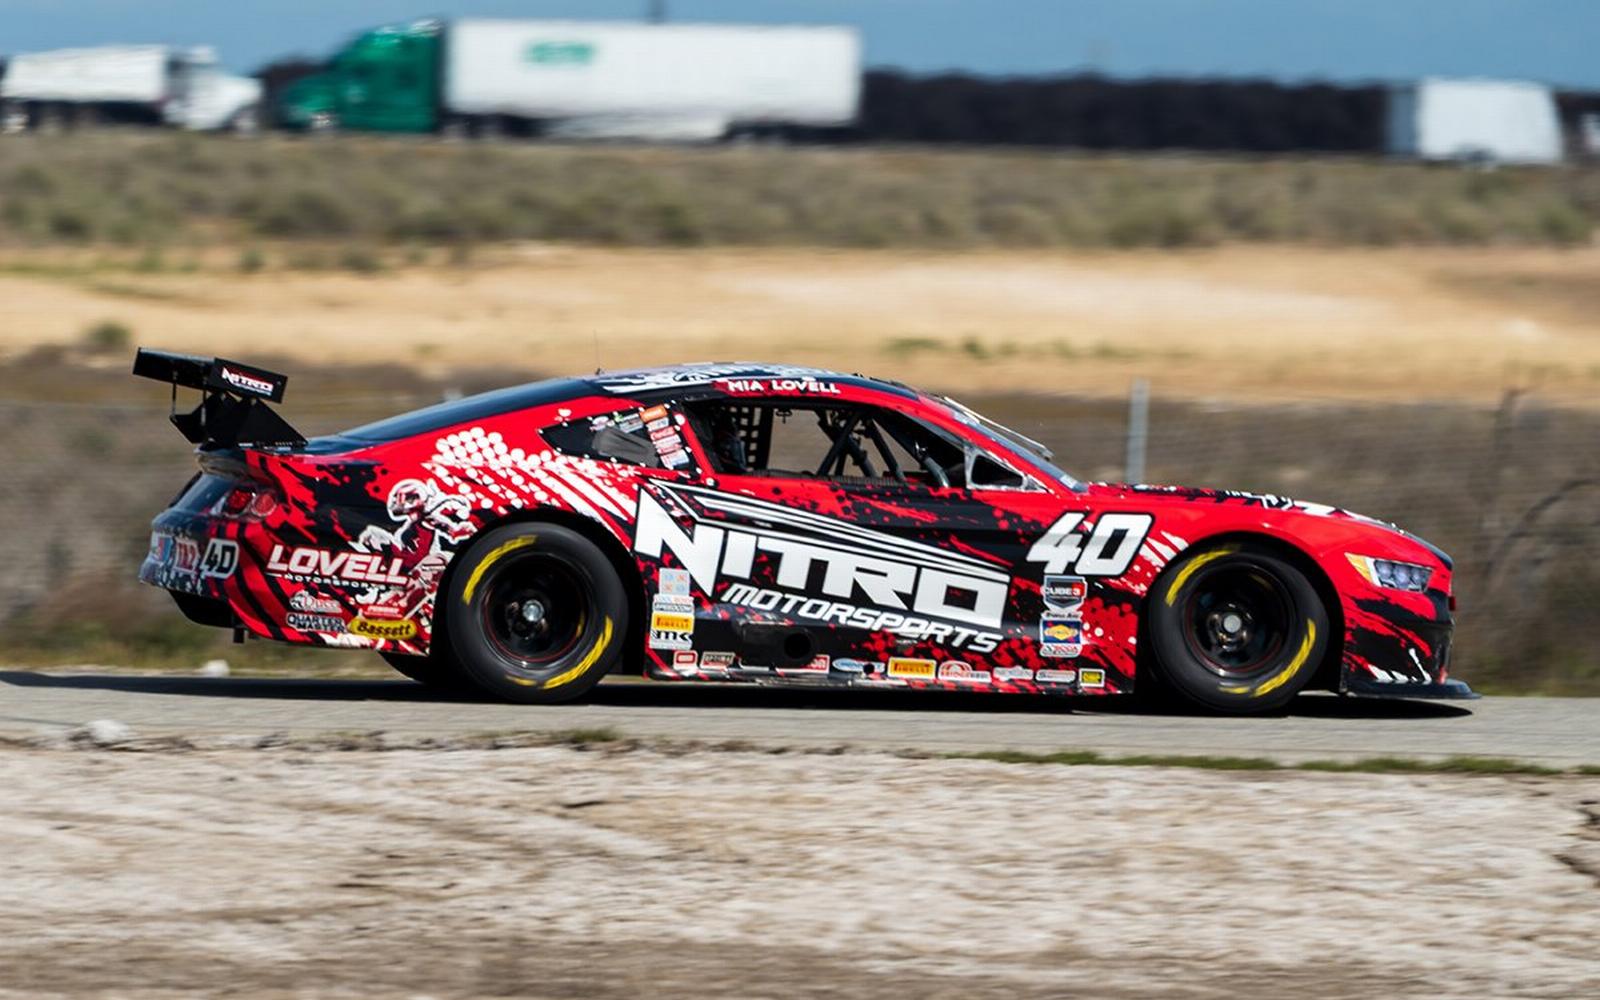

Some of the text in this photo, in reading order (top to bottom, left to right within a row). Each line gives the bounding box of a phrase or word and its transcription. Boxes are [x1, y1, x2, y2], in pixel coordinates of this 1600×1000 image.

[221, 368, 274, 392] NITRO
[727, 379, 841, 394] MIA LOVELL
[266, 544, 408, 585] LOVELL
[634, 486, 1009, 629] NITRO
[1026, 512, 1153, 575] 40
[720, 582, 1004, 653] MOTORSPORTS
